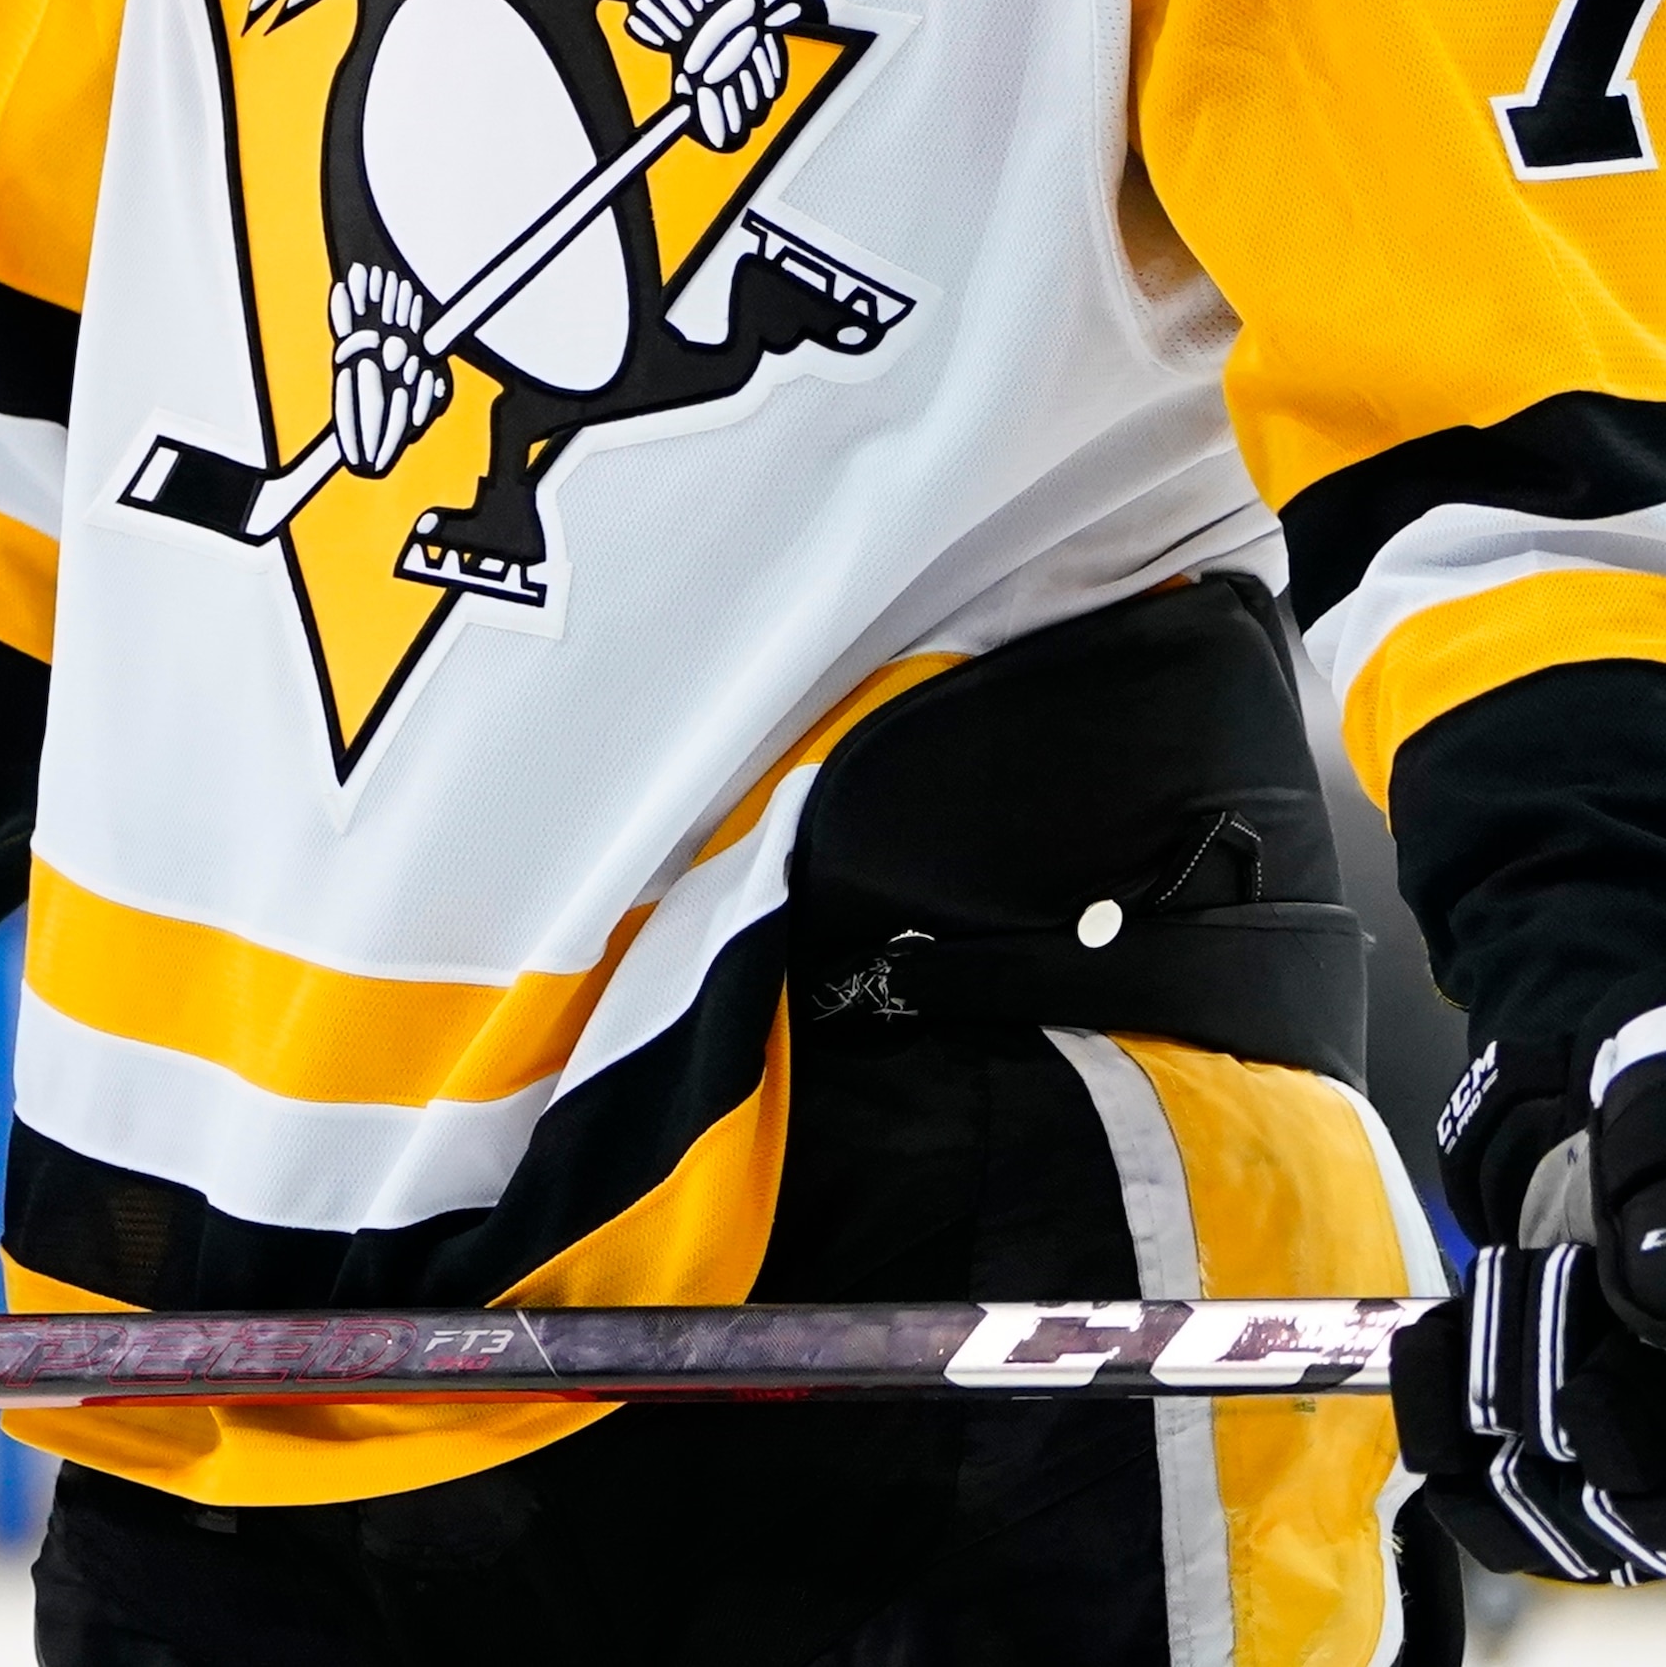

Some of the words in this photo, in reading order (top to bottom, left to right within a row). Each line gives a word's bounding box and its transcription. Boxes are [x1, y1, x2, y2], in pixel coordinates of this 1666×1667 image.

[1436, 1039, 1498, 1147] CCM
[1455, 1089, 1482, 1138] PRO
[423, 1329, 515, 1354] FT3
